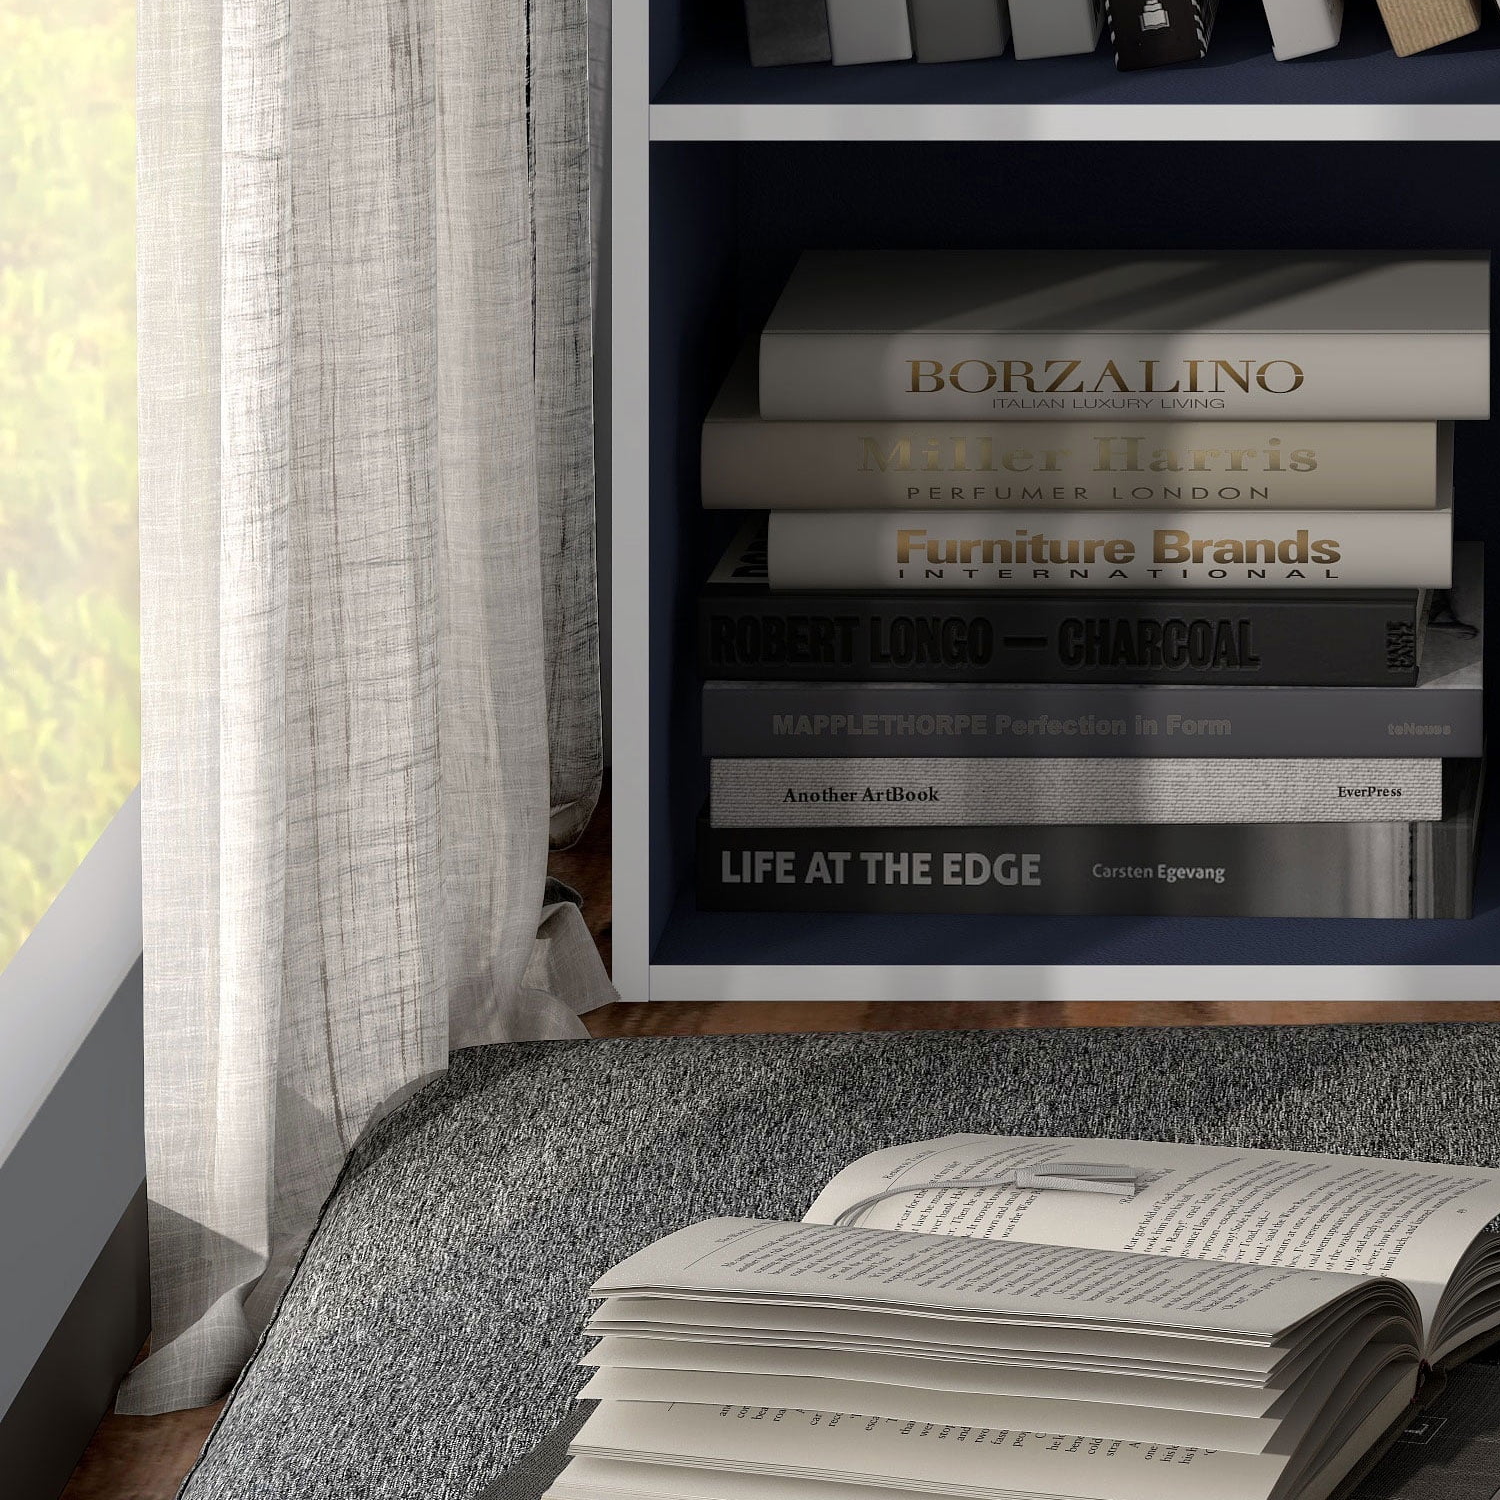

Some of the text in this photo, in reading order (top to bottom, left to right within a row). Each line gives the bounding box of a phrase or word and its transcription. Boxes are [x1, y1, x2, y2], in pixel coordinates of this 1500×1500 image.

[904, 359, 1305, 394] BORZALINO
[992, 398, 1226, 409] ITALIAN LUXURY LIVING
[856, 435, 1319, 472] Miller Harris
[907, 487, 1270, 500] PERFUMER LONDON
[896, 529, 1342, 565] Furniture Brands
[899, 568, 1340, 579] INTERNATIONAL
[709, 614, 860, 668] ROBERT
[868, 615, 994, 669] LONGO
[1058, 617, 1263, 671] CHARCOAL
[772, 713, 1233, 736] MAPPLETHORPE Perfection in Form
[783, 786, 940, 803] Another ArtBook
[1338, 786, 1402, 798] EverPress
[721, 850, 1042, 886] LIFE AT THE EDGE
[1093, 863, 1227, 884] Carsten Egevang
